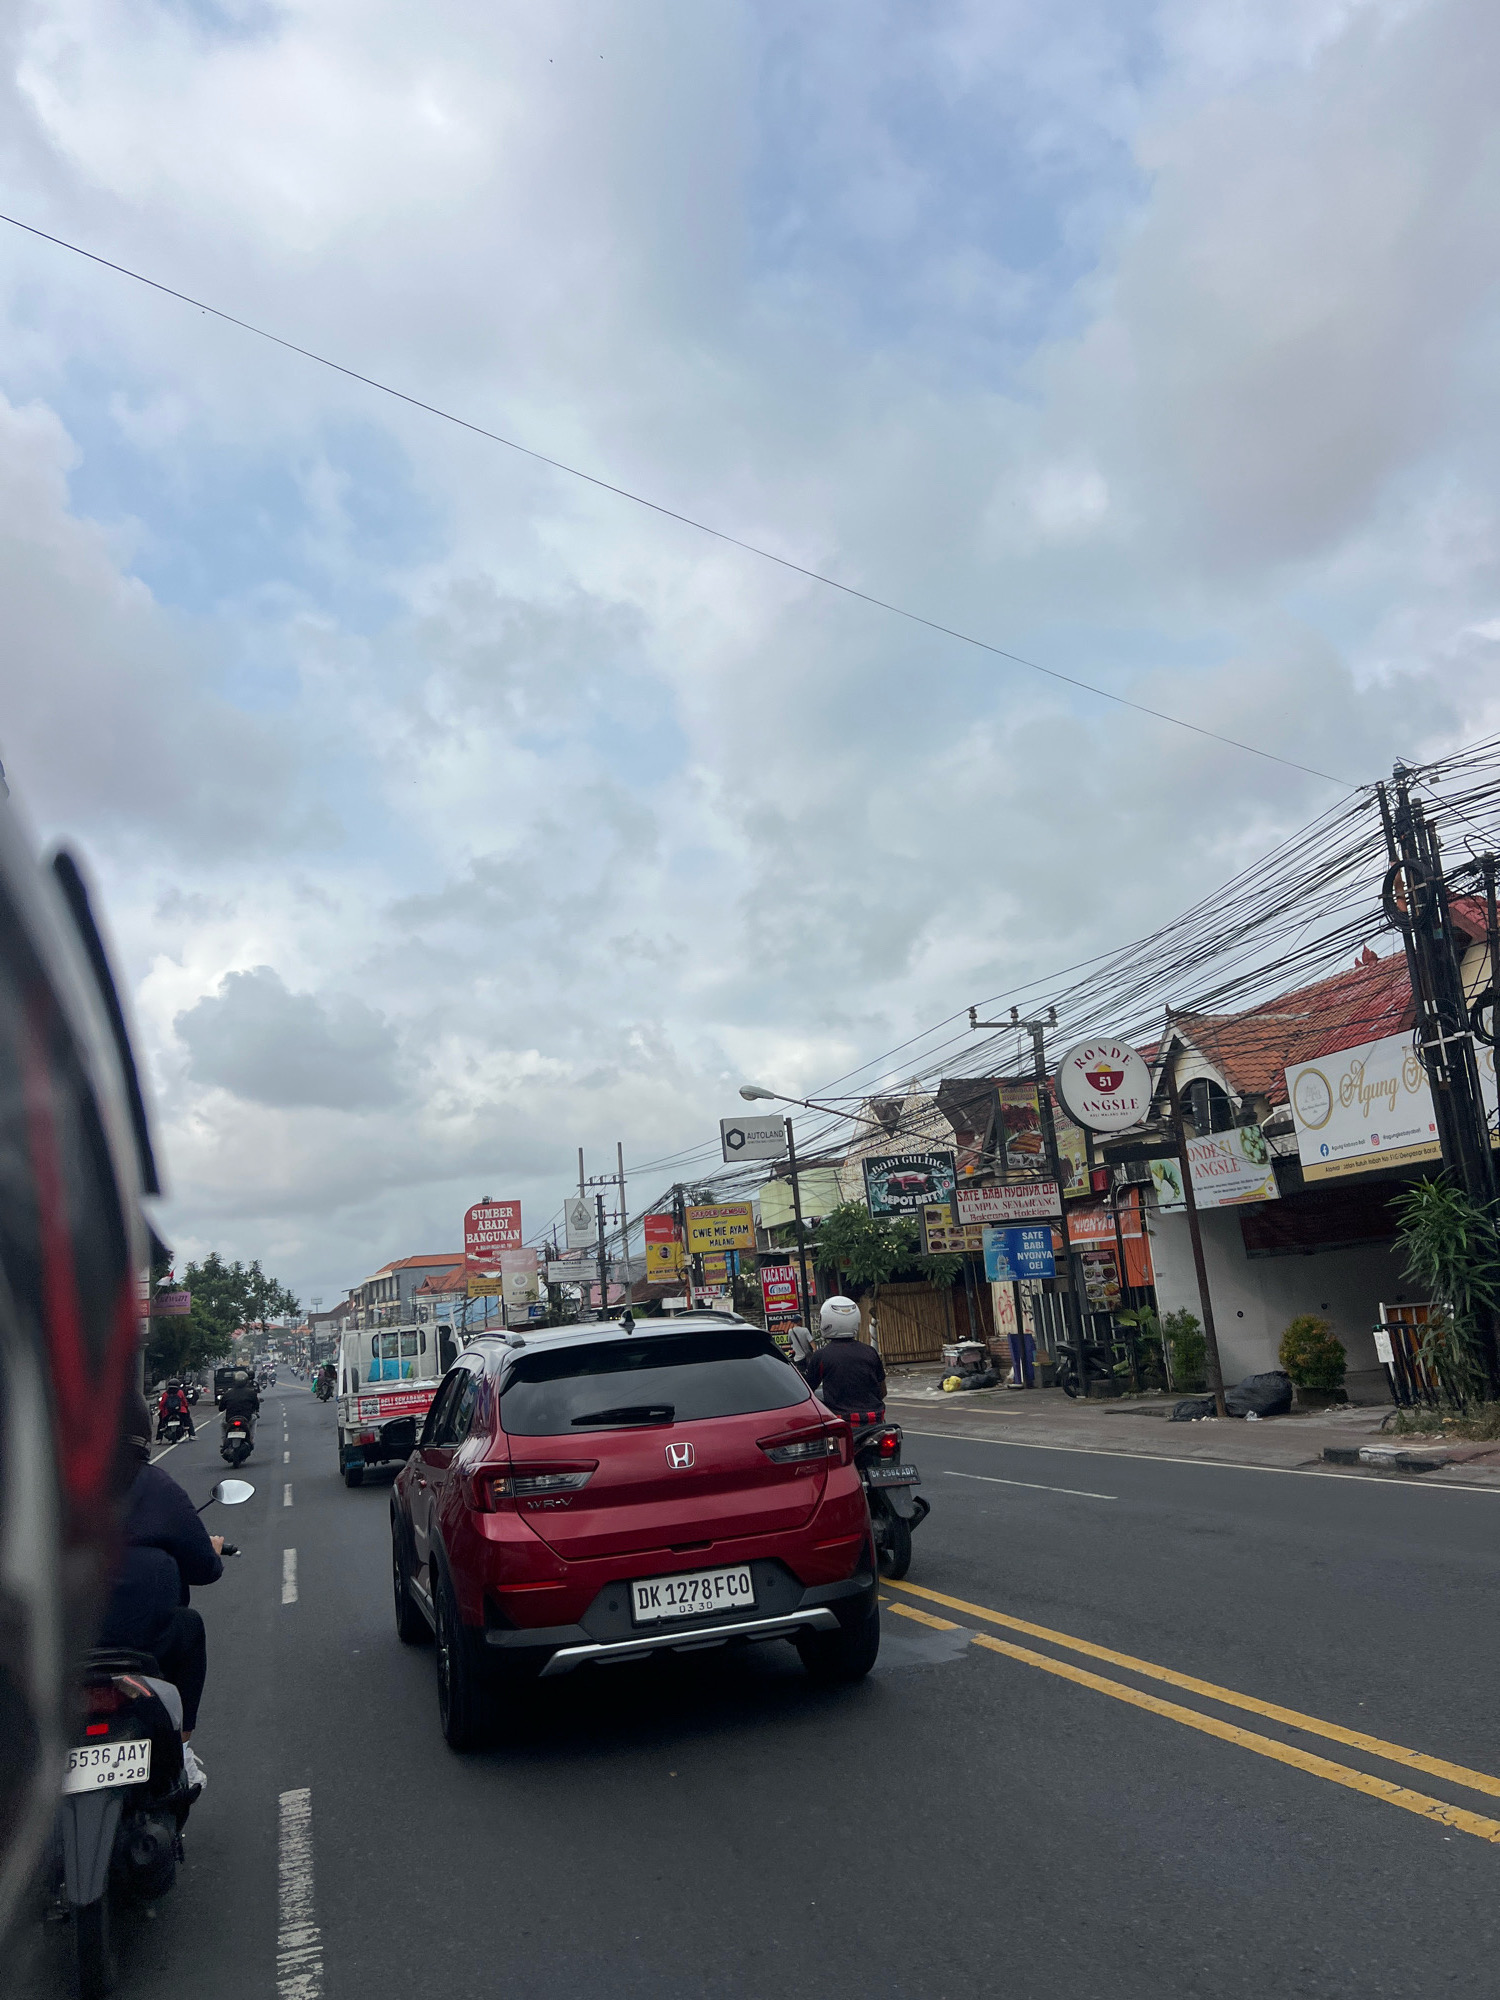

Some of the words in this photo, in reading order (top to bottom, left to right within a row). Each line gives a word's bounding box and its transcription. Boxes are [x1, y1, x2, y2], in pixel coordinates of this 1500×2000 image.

[1074, 1045, 1133, 1070] RONDE
[1099, 1076, 1112, 1087] 51
[1339, 1059, 1400, 1118] Agung
[1081, 1098, 1139, 1112] ANGSLE
[747, 1130, 784, 1140] AUTOLAND
[1195, 1158, 1241, 1179] ANGSLE
[880, 1194, 913, 1206] DEPOT
[915, 1189, 944, 1205] BETTY
[957, 1189, 980, 1202] SATE
[982, 1187, 1003, 1199] BABI
[1004, 1184, 1040, 1198] NYONYA
[1042, 1183, 1058, 1195] OEI
[962, 1202, 998, 1213] LUMPIA
[1002, 1197, 1056, 1209] SEMARANG
[471, 1207, 514, 1220] SUMBER
[477, 1219, 509, 1231] ABADI
[693, 1228, 712, 1239] CWIE
[714, 1226, 727, 1236] MIE
[730, 1224, 749, 1235] AYAM
[466, 1229, 520, 1244] BANGUNAN
[709, 1237, 735, 1247] MALANG
[1022, 1231, 1044, 1240] SATE
[1023, 1241, 1045, 1250] BABI
[1017, 1250, 1053, 1261] NYONYA
[1029, 1261, 1043, 1270] OEI
[763, 1268, 779, 1283] KACA
[780, 1266, 794, 1281] FILM
[527, 1497, 573, 1508] WR-V
[637, 1585, 661, 1610] DK
[665, 1578, 713, 1606] 1278
[679, 1604, 693, 1613] 03
[699, 1601, 713, 1611] 30
[117, 1743, 148, 1762] AAY
